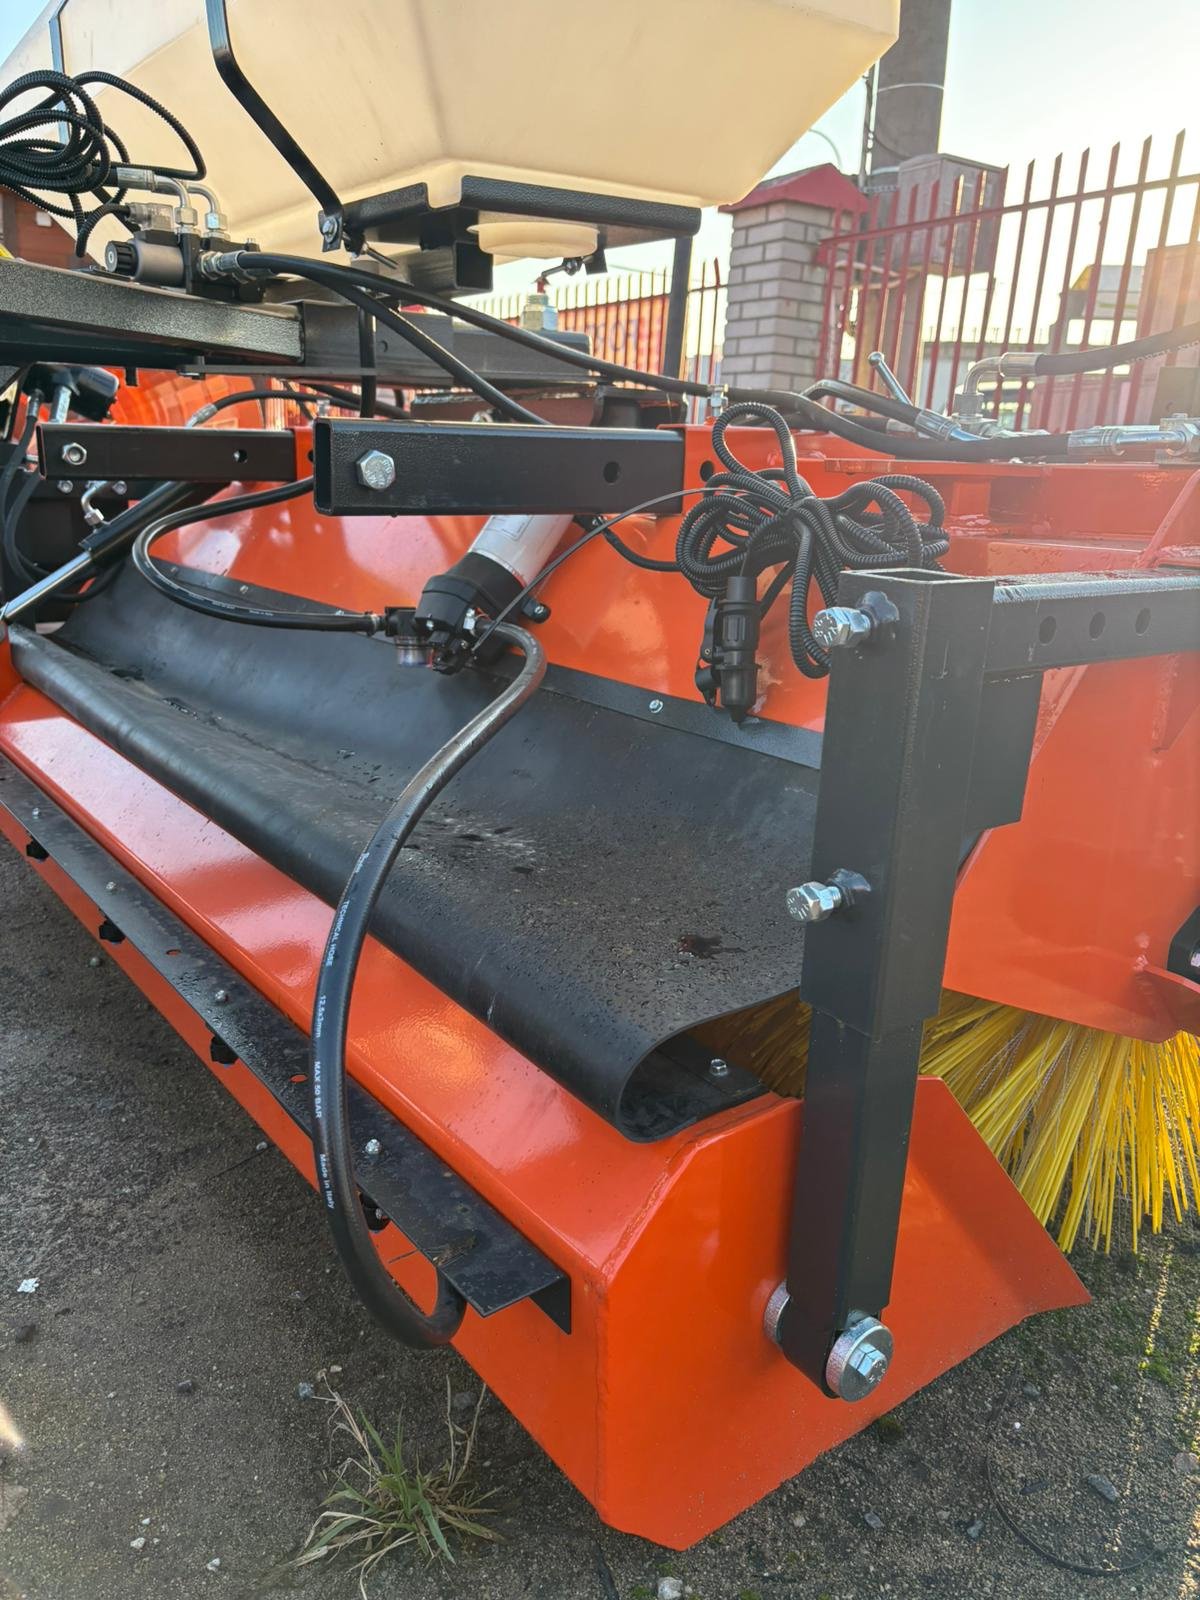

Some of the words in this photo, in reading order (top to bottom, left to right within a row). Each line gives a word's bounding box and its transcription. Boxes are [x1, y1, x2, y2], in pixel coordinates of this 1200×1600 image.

[331, 900, 350, 942] TECHNICAL
[326, 944, 337, 967] HOSE
[314, 1085, 321, 1095] 50
[314, 1097, 322, 1118] BAR
[319, 1153, 328, 1178] Made
[325, 1190, 335, 1209] Italy
